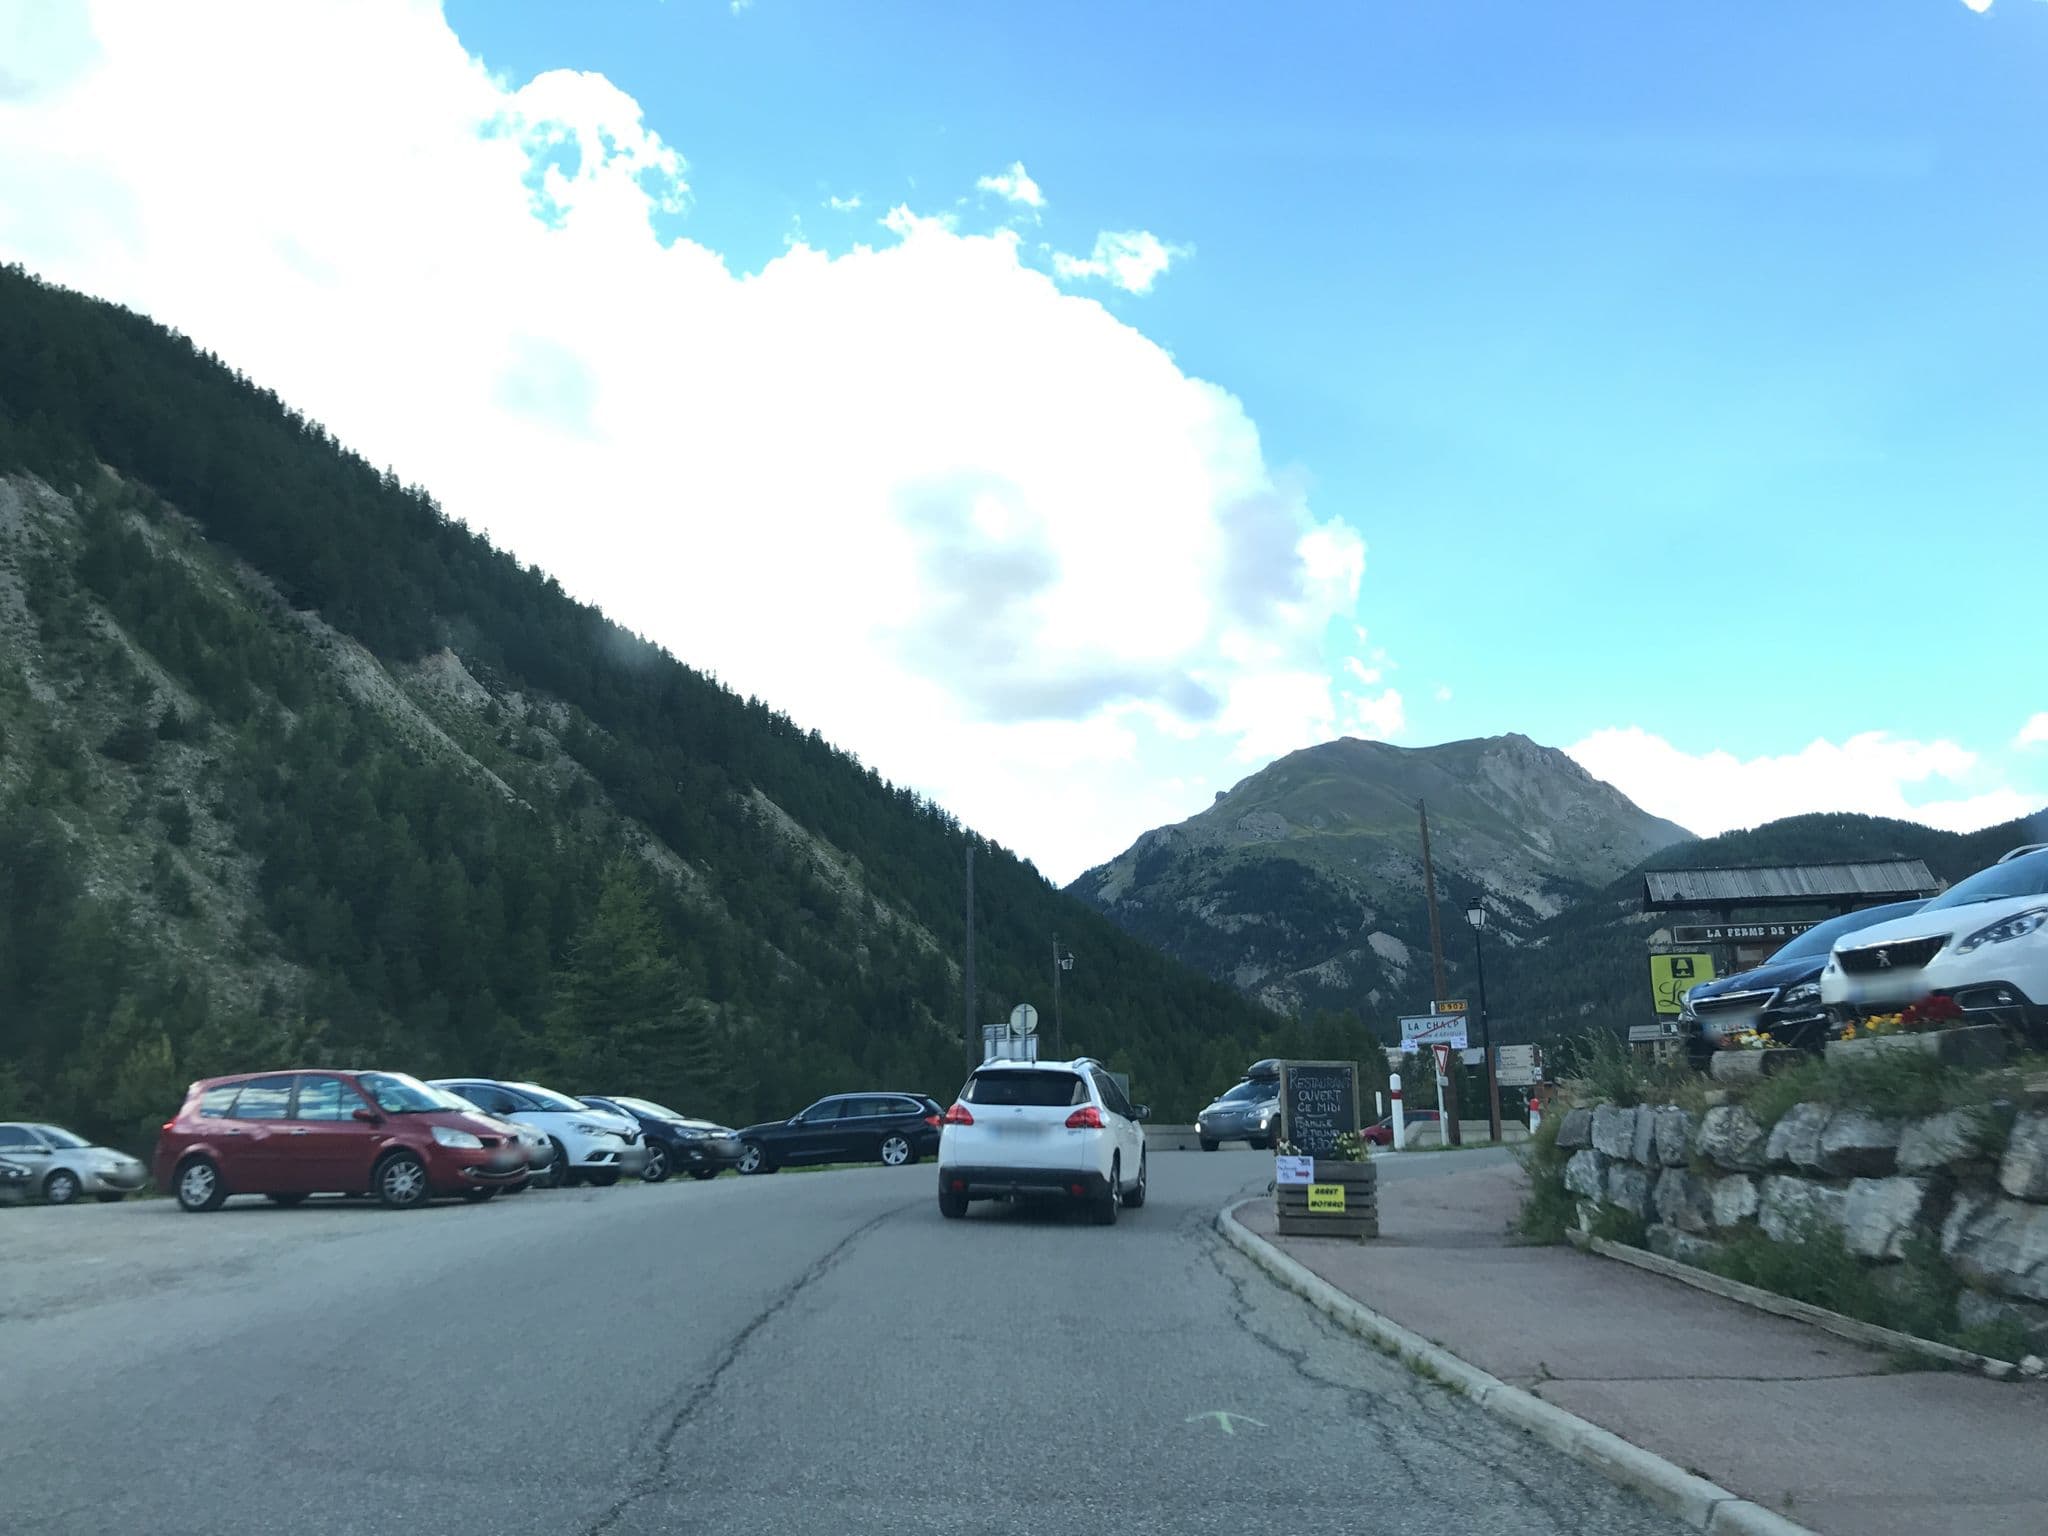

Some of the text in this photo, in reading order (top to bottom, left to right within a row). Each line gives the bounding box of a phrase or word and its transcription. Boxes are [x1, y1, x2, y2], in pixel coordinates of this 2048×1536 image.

[1706, 929, 1722, 938] LA
[1727, 927, 1765, 938] FERME
[1770, 926, 1785, 935] DE
[1407, 1022, 1420, 1031] LA
[1288, 1067, 1351, 1089] RESTAURANT
[1298, 1089, 1342, 1102] OUVERT
[1297, 1102, 1341, 1113] CE MIDI
